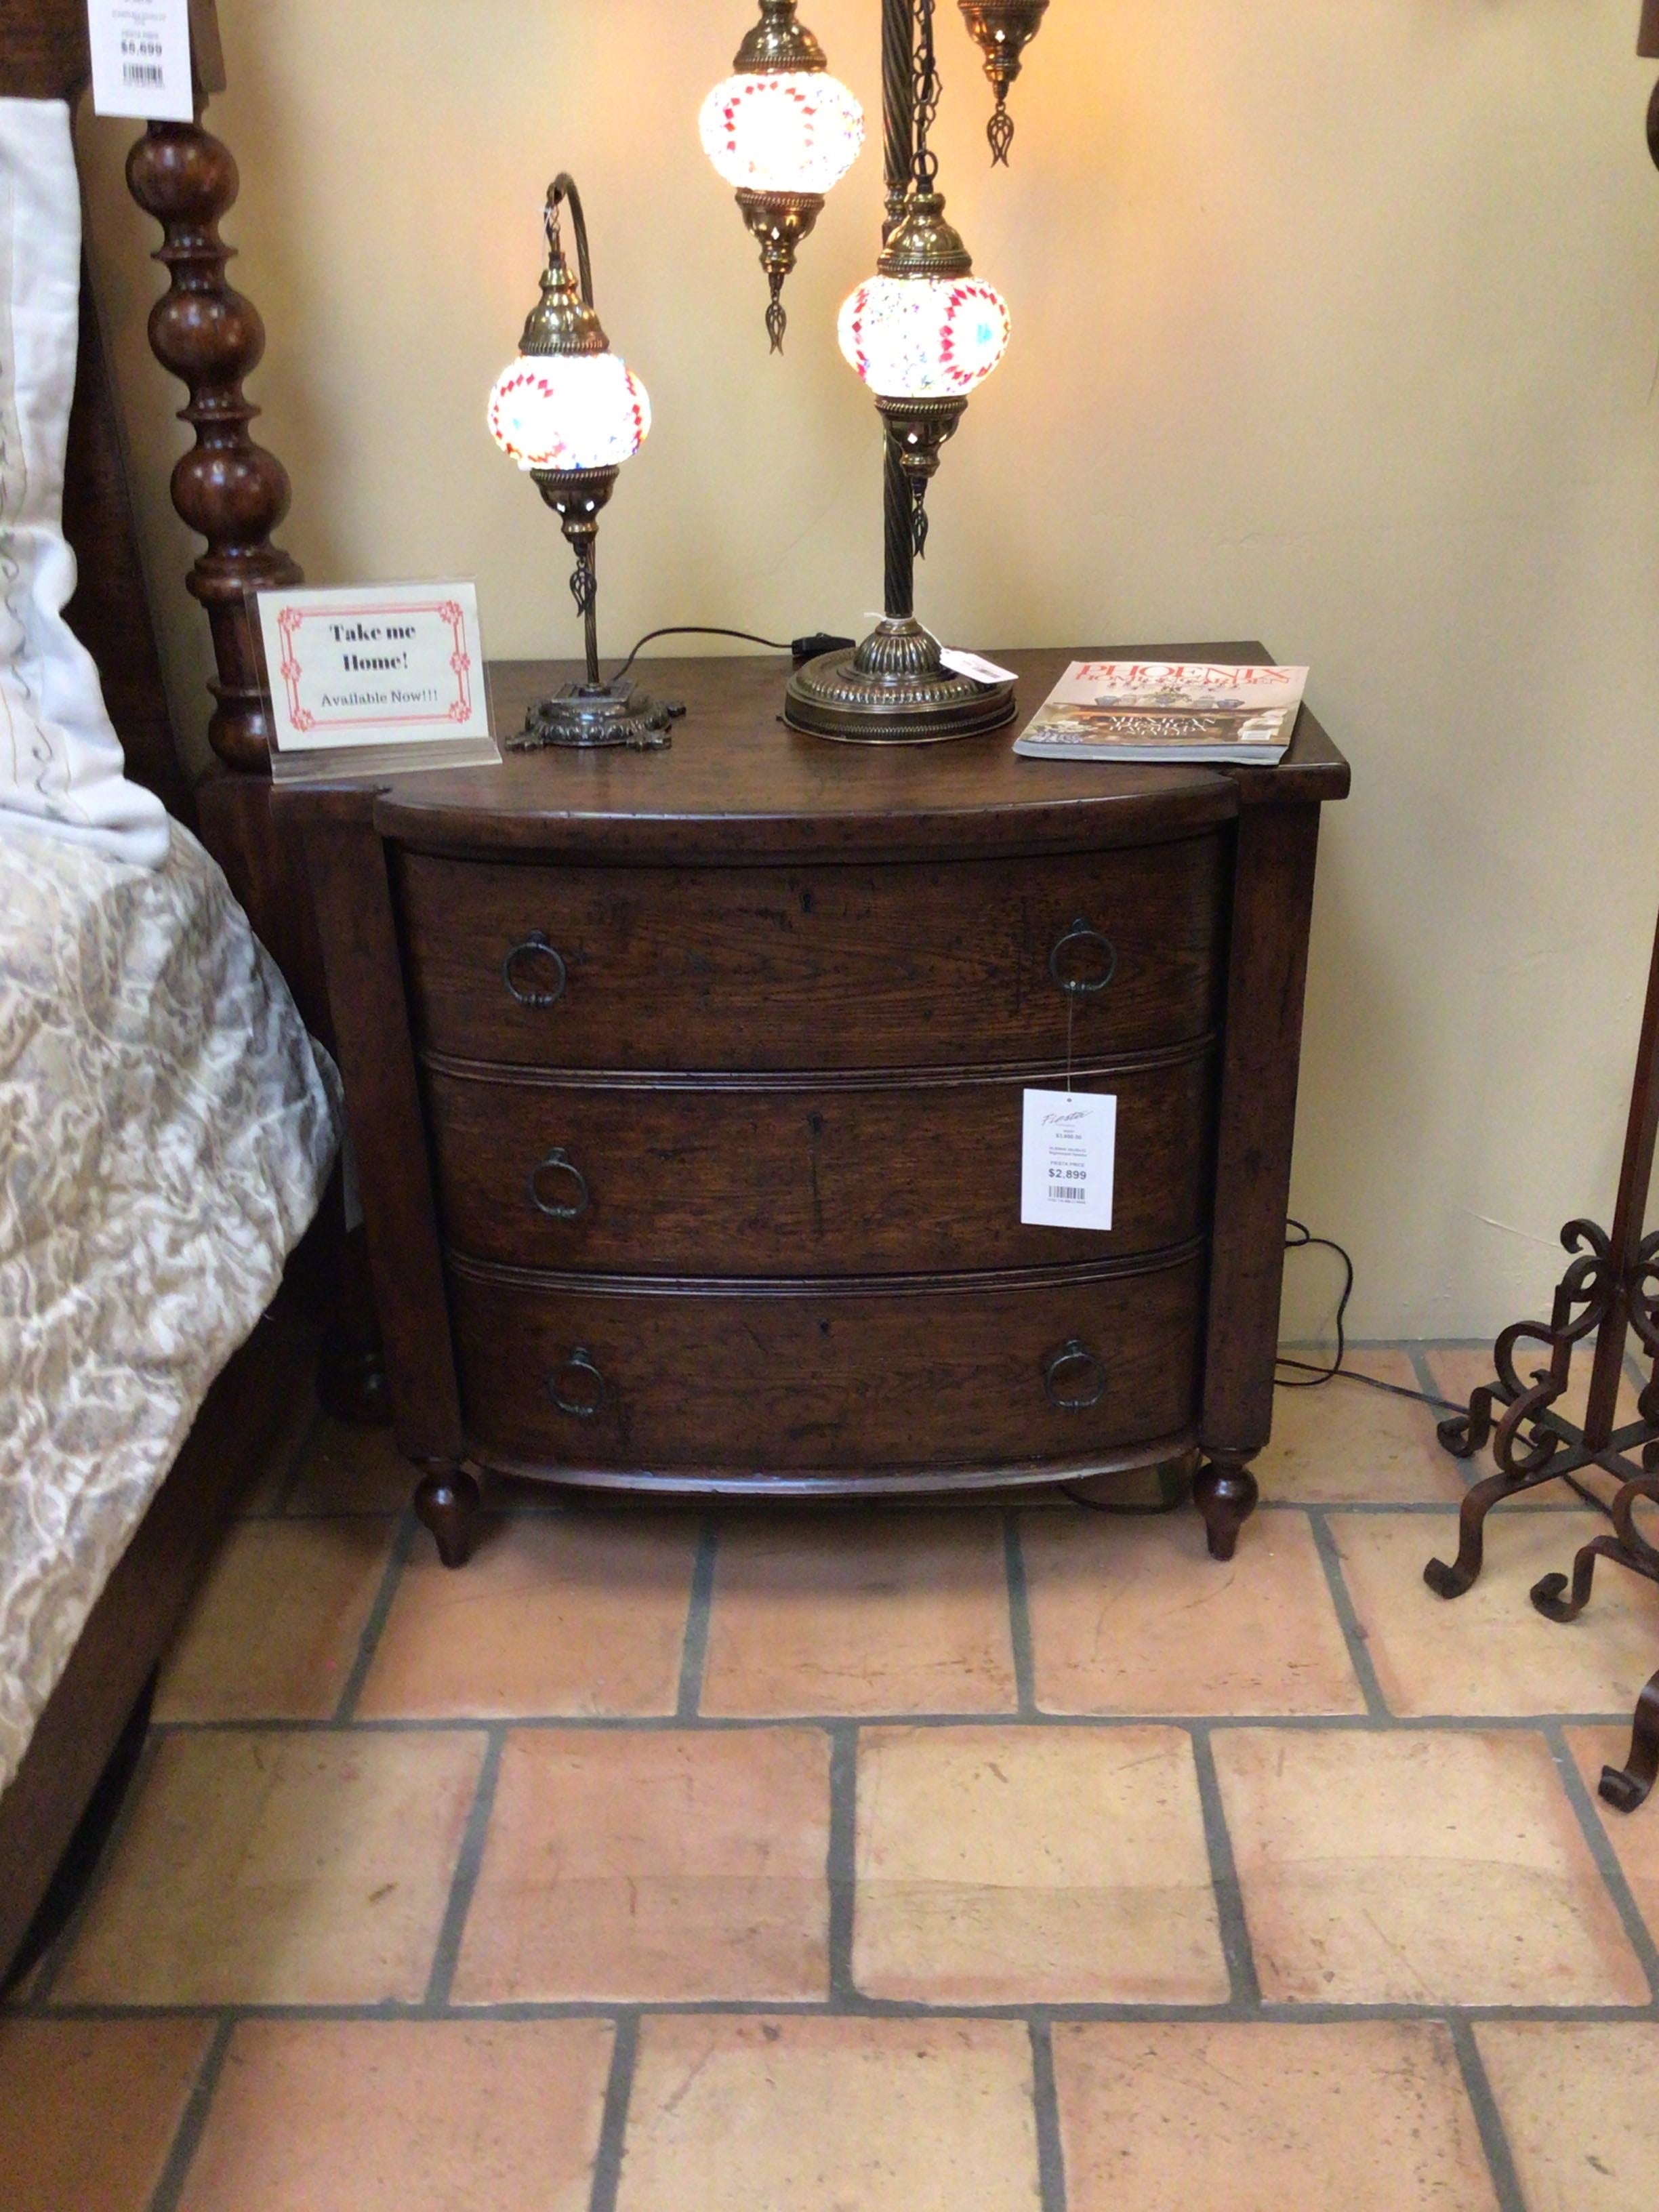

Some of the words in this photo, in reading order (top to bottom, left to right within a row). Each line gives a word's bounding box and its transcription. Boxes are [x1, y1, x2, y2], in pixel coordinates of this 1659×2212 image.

[329, 623, 382, 642] Take
[386, 626, 416, 639] me
[343, 652, 408, 672] Home!
[1078, 663, 1292, 678] PHOENIX
[321, 692, 388, 707] Available
[391, 689, 438, 703] Now!!!
[1048, 1168, 1086, 1180] $2,899
